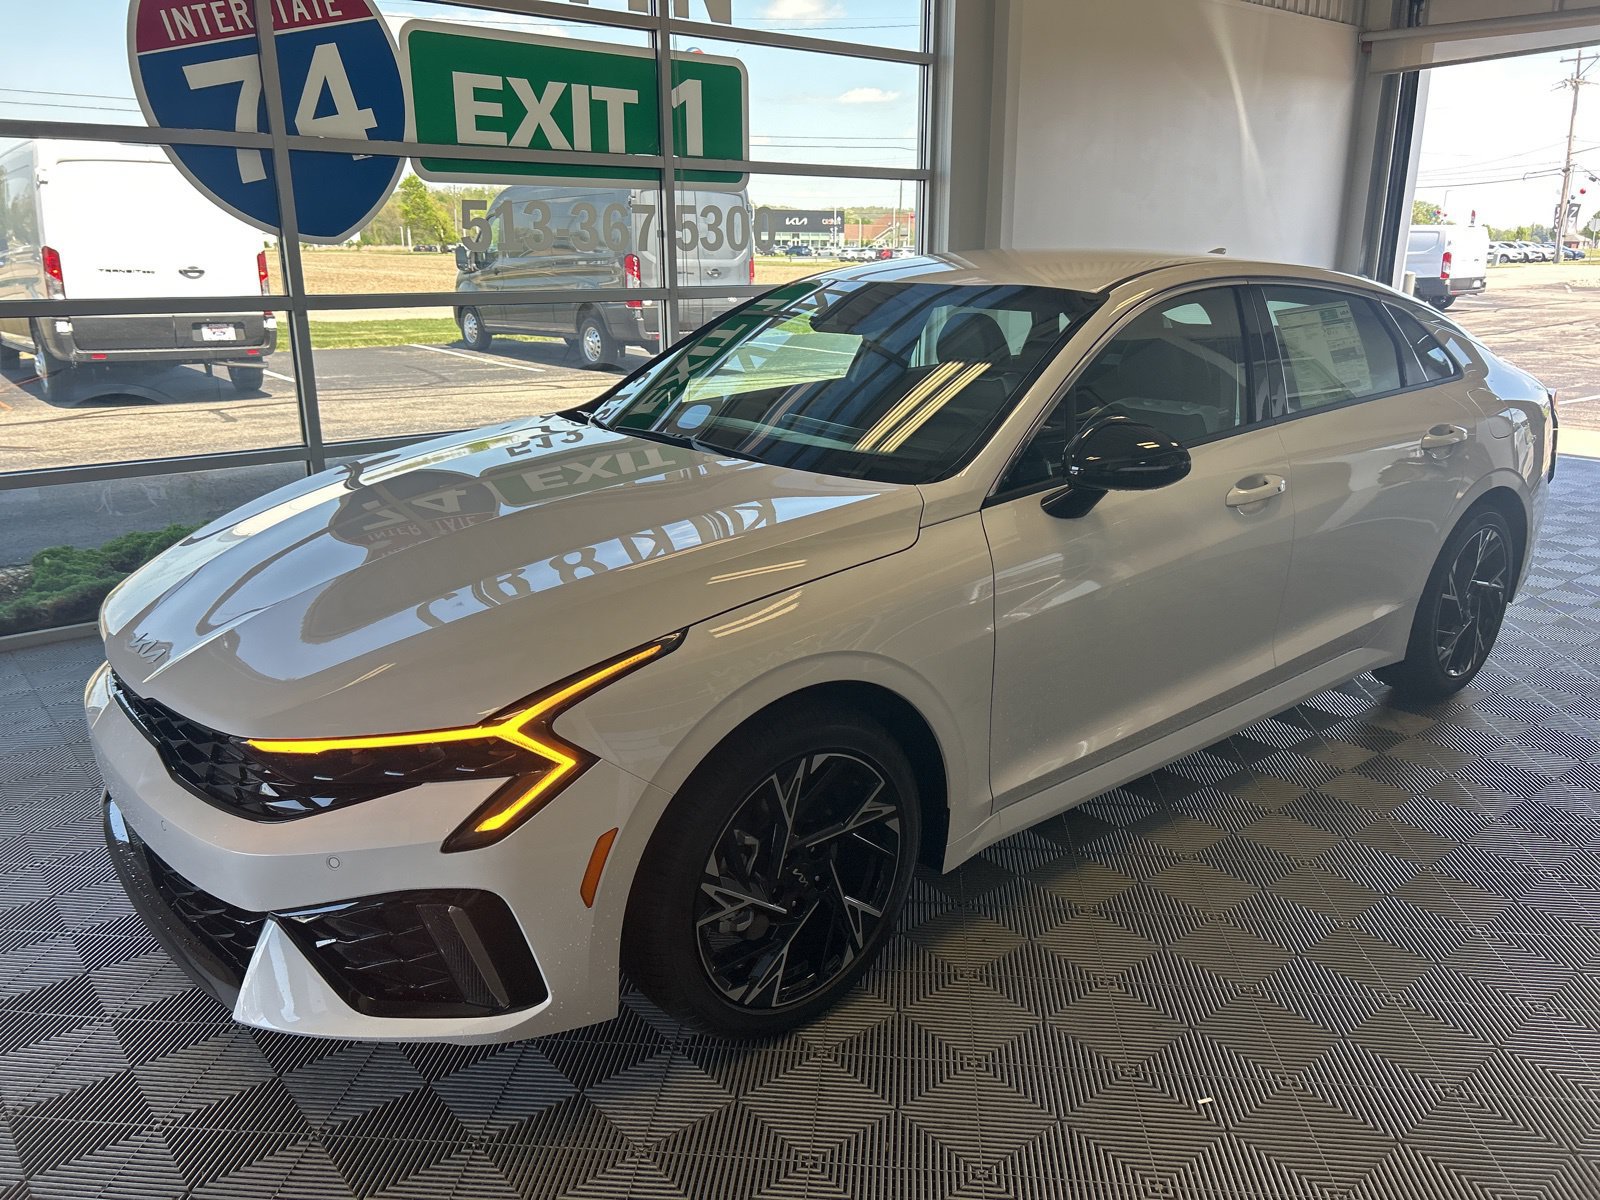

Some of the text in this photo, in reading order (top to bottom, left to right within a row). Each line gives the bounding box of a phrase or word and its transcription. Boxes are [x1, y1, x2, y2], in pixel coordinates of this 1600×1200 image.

[160, 0, 342, 42] INTERTATE
[182, 42, 378, 184] 74
[452, 70, 704, 157] EXIT 1
[785, 217, 808, 225] KIA
